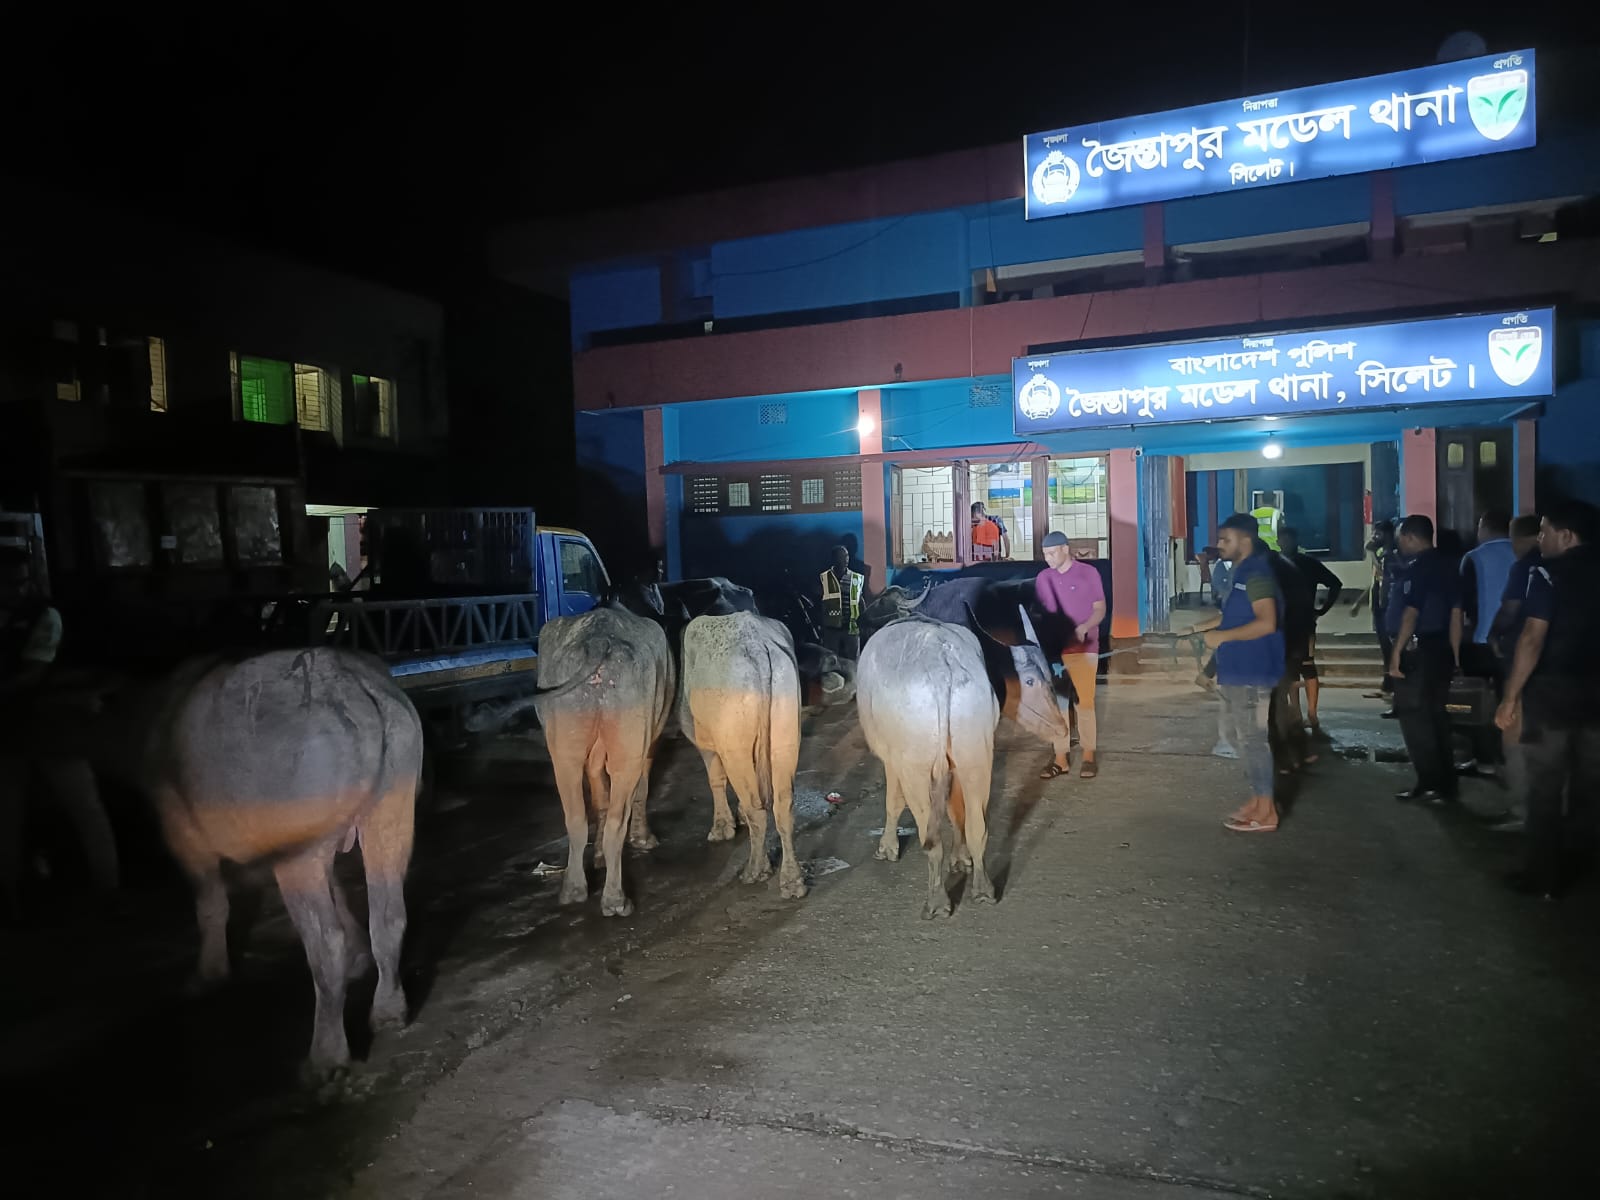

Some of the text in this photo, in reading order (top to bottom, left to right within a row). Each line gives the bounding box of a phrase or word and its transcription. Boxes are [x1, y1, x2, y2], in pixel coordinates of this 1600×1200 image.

[1082, 84, 1464, 178] জৈন্তাপুর মডেল থানা
[1169, 340, 1357, 375] বাংলাদেশ পুলিশ
[1065, 385, 1171, 418] জৈন্তাপুর
[1176, 379, 1260, 409] মডেল
